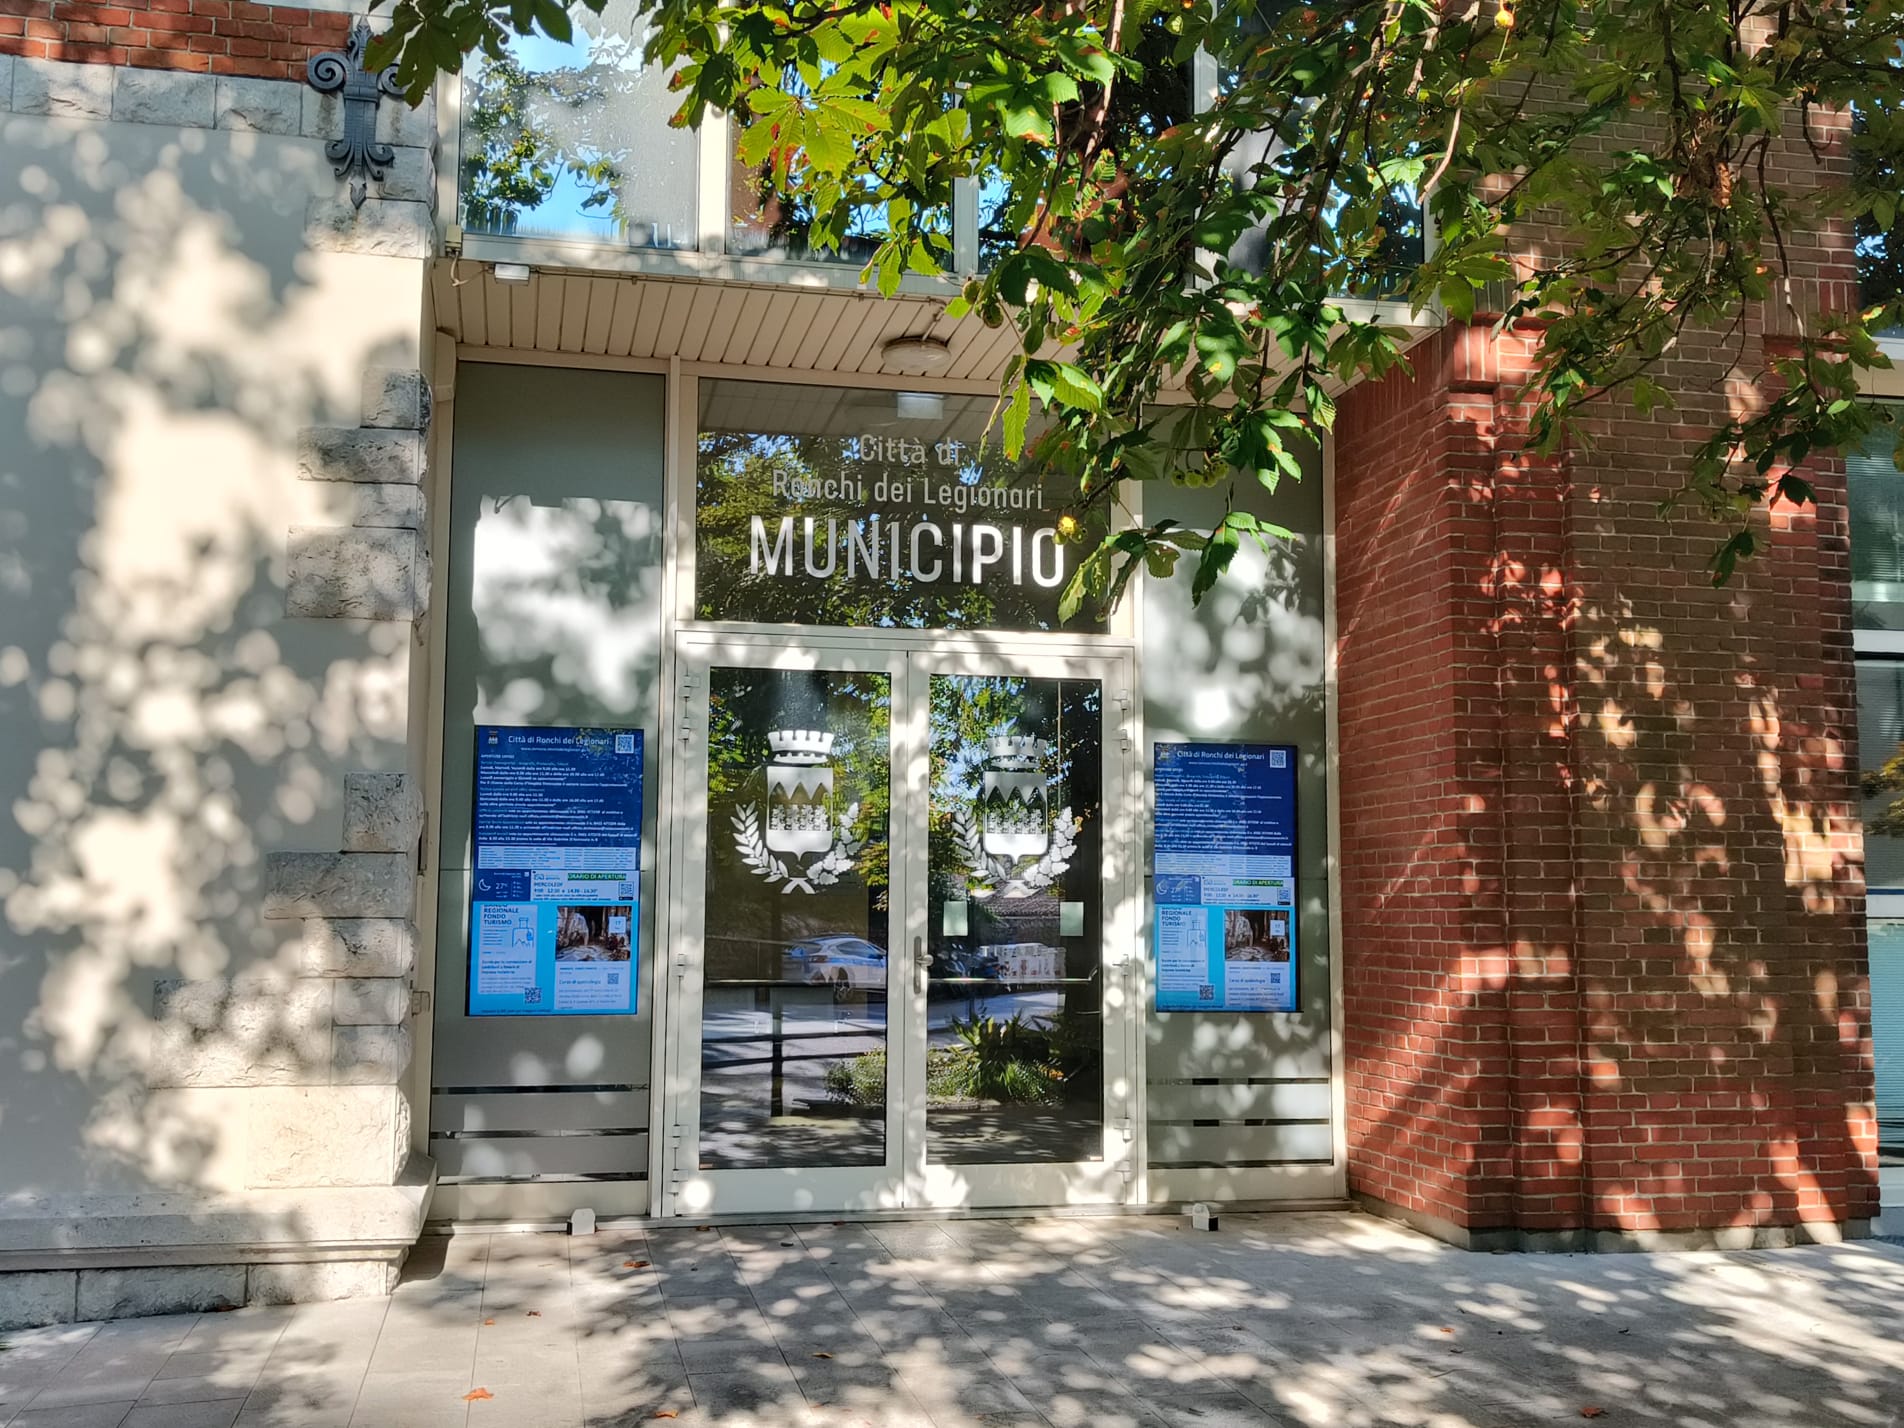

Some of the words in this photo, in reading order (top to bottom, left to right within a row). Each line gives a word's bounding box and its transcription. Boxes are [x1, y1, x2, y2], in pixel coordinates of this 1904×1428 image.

[860, 434, 926, 464] Città
[937, 436, 960, 466] di
[772, 470, 862, 501] Ronchi
[874, 473, 912, 503] dei
[924, 477, 1043, 514] Legionari
[750, 515, 1065, 588] MUNICIPIO
[508, 735, 526, 743] Città
[527, 735, 534, 743] di
[536, 736, 561, 744] Ronchi
[563, 736, 574, 744] dei
[576, 737, 609, 746] Legionari
[1177, 750, 1192, 758] Città
[1201, 751, 1223, 759] Ronchi
[1235, 752, 1265, 761] Legionari
